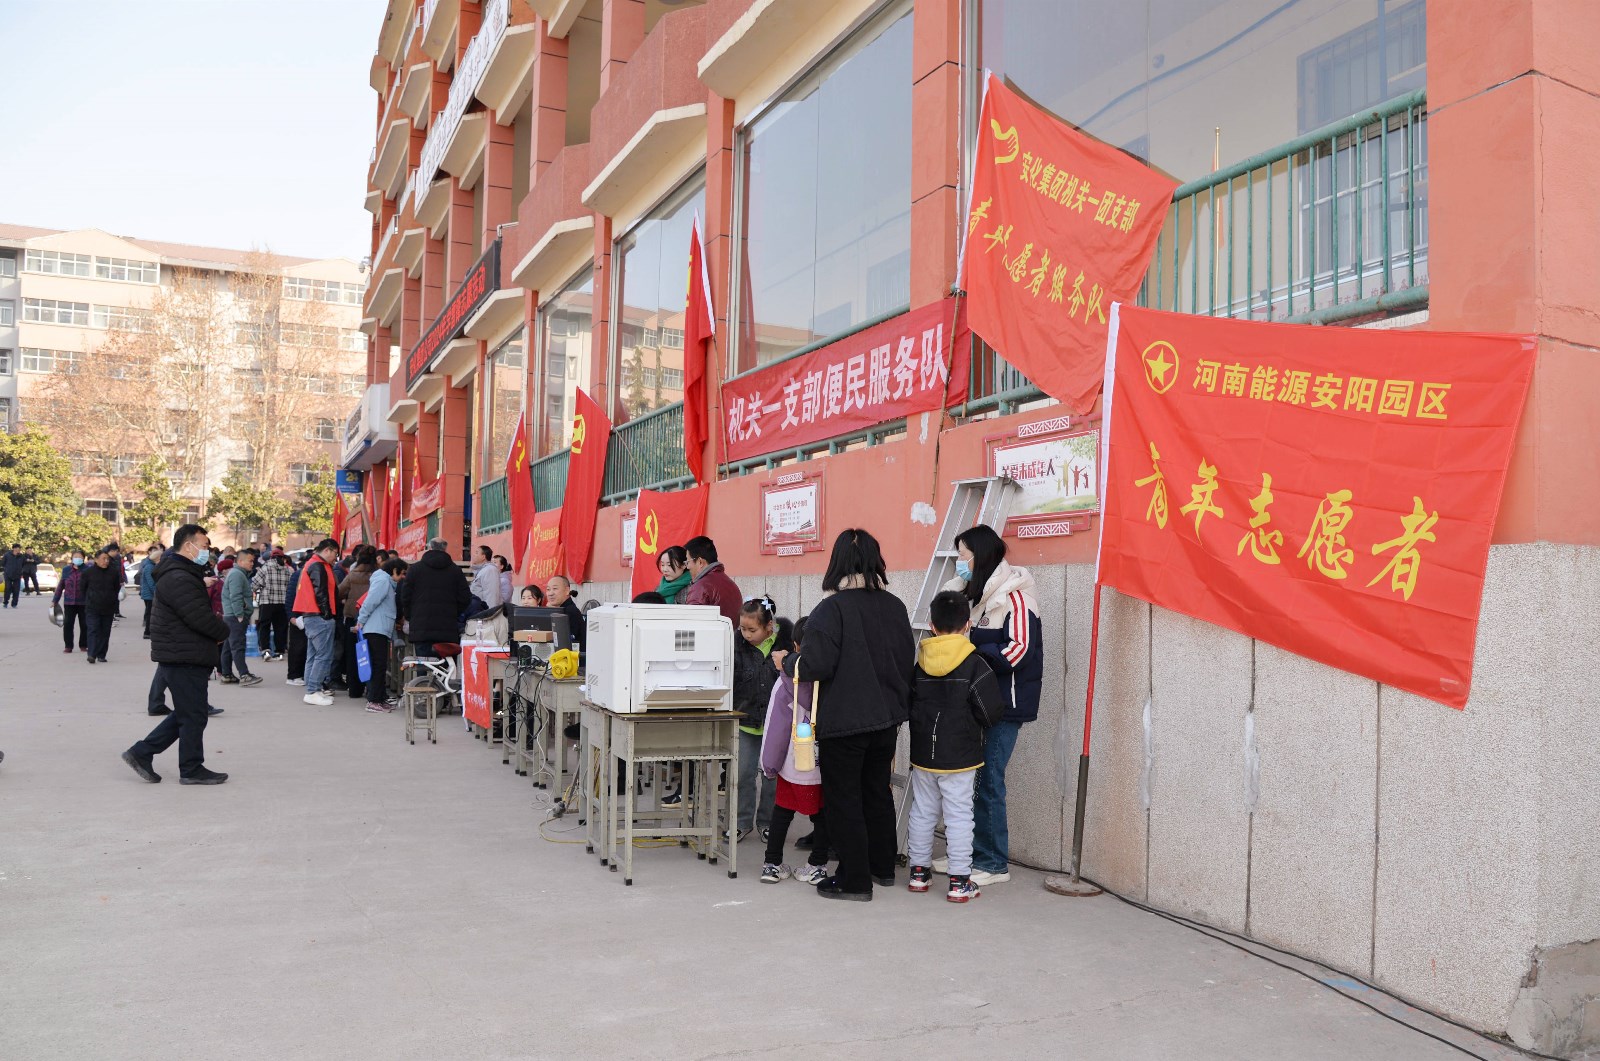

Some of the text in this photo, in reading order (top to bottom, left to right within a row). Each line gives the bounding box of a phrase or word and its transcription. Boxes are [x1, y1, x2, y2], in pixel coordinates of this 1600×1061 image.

[1018, 151, 1140, 234] 安化集团机关一团支部
[728, 322, 950, 444] 机关一支部便民服务队
[1191, 356, 1453, 421] 河南能源安阳园区
[1002, 458, 1056, 481] 关爱未成年人
[1133, 441, 1440, 601] 青年志愿者
